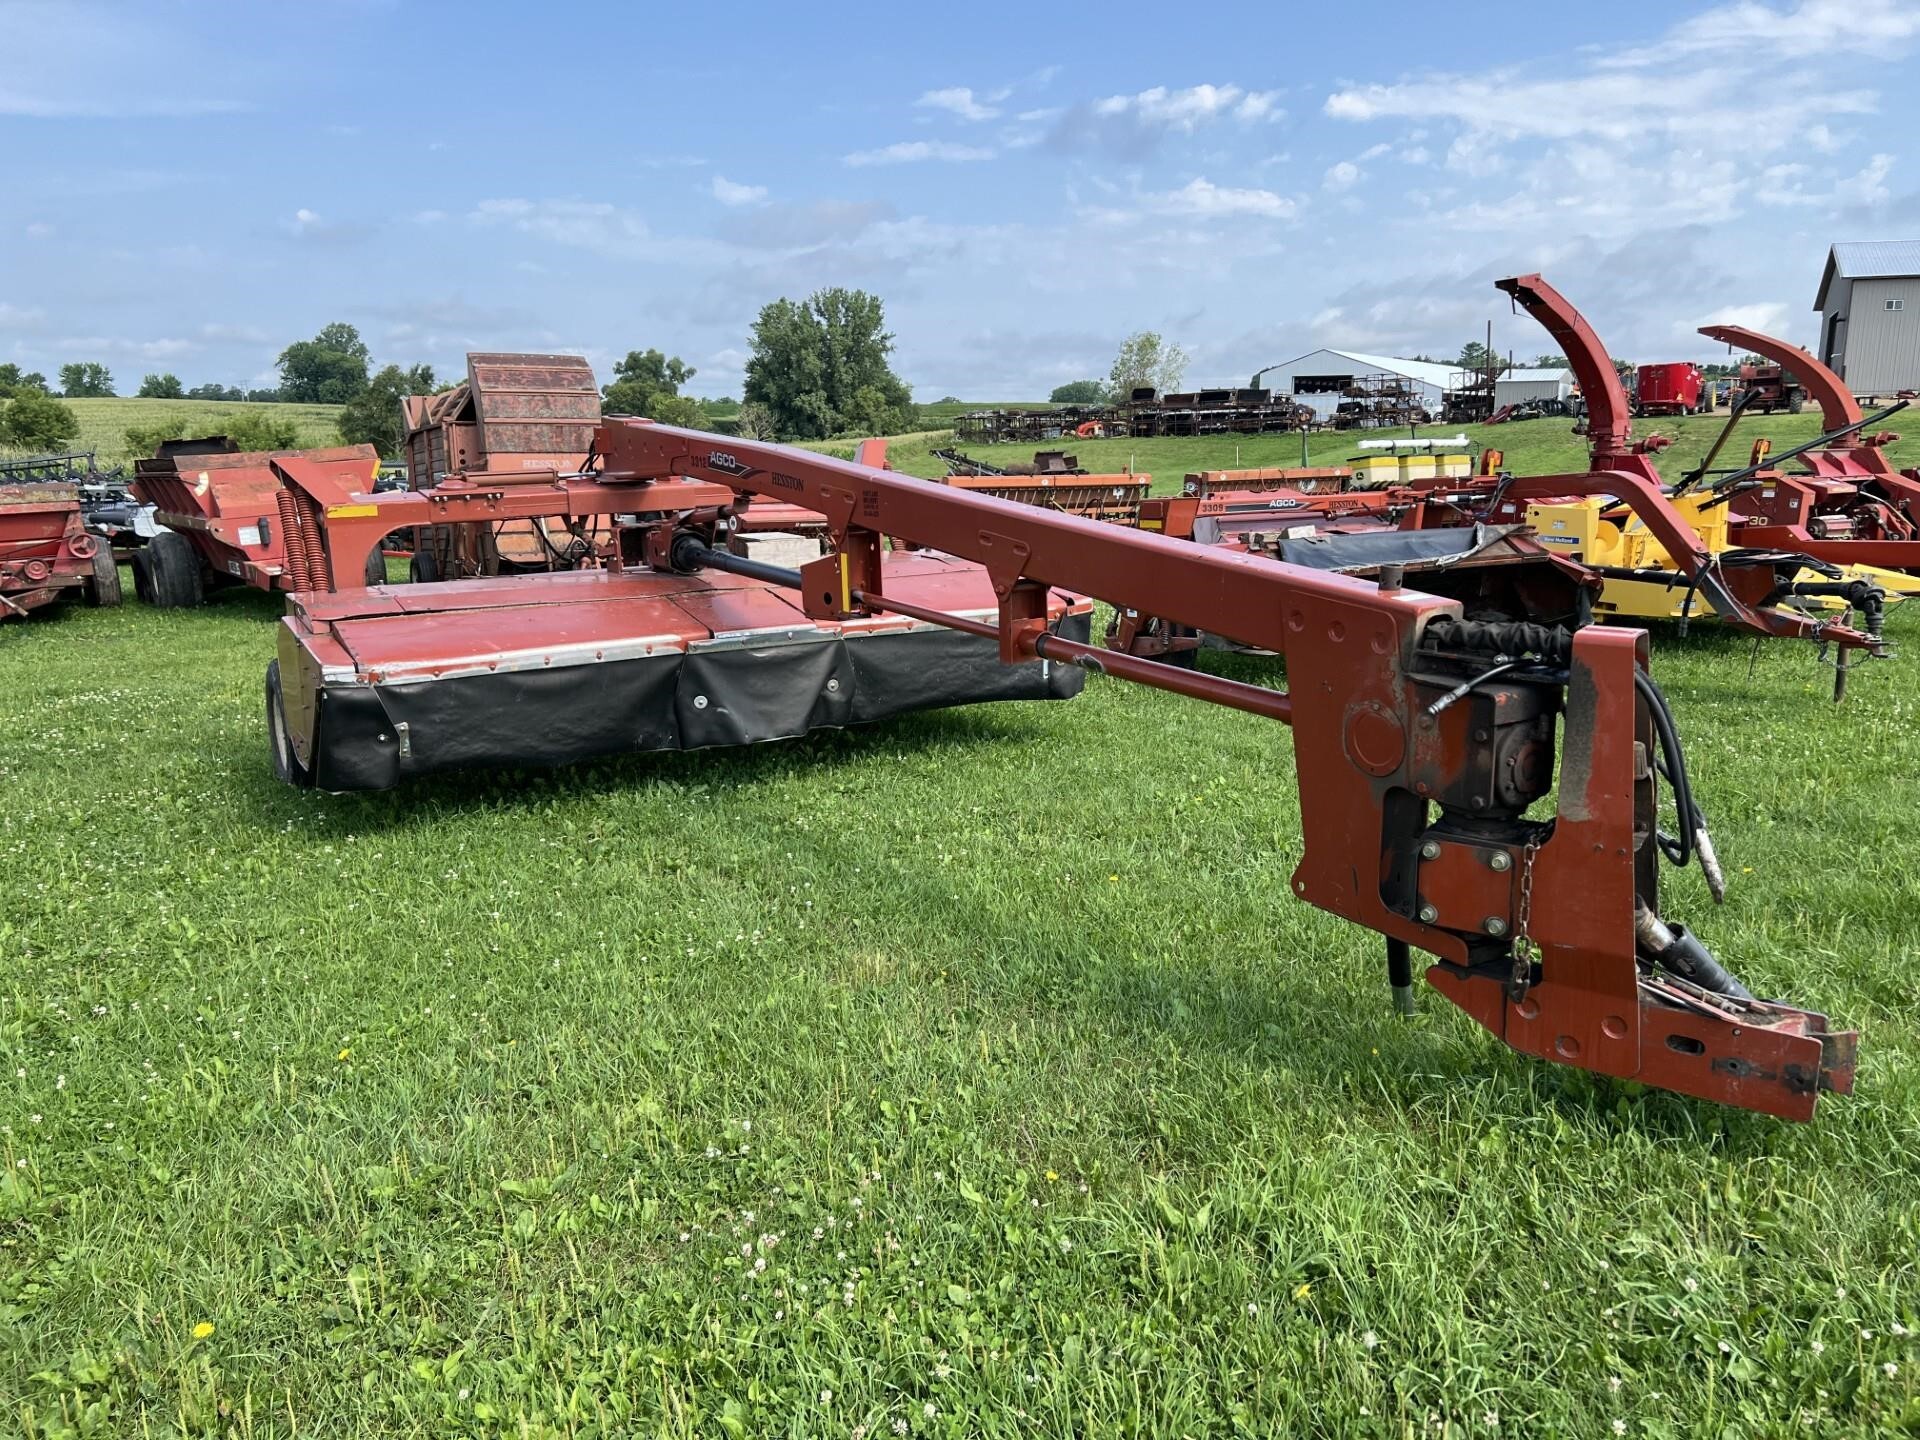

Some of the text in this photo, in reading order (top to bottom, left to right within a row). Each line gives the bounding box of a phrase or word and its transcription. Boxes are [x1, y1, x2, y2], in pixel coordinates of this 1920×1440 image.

[709, 451, 736, 468] AGCO
[771, 471, 804, 492] HESSTON
[1268, 498, 1296, 508] AGCO
[1328, 499, 1358, 510] HESSTON
